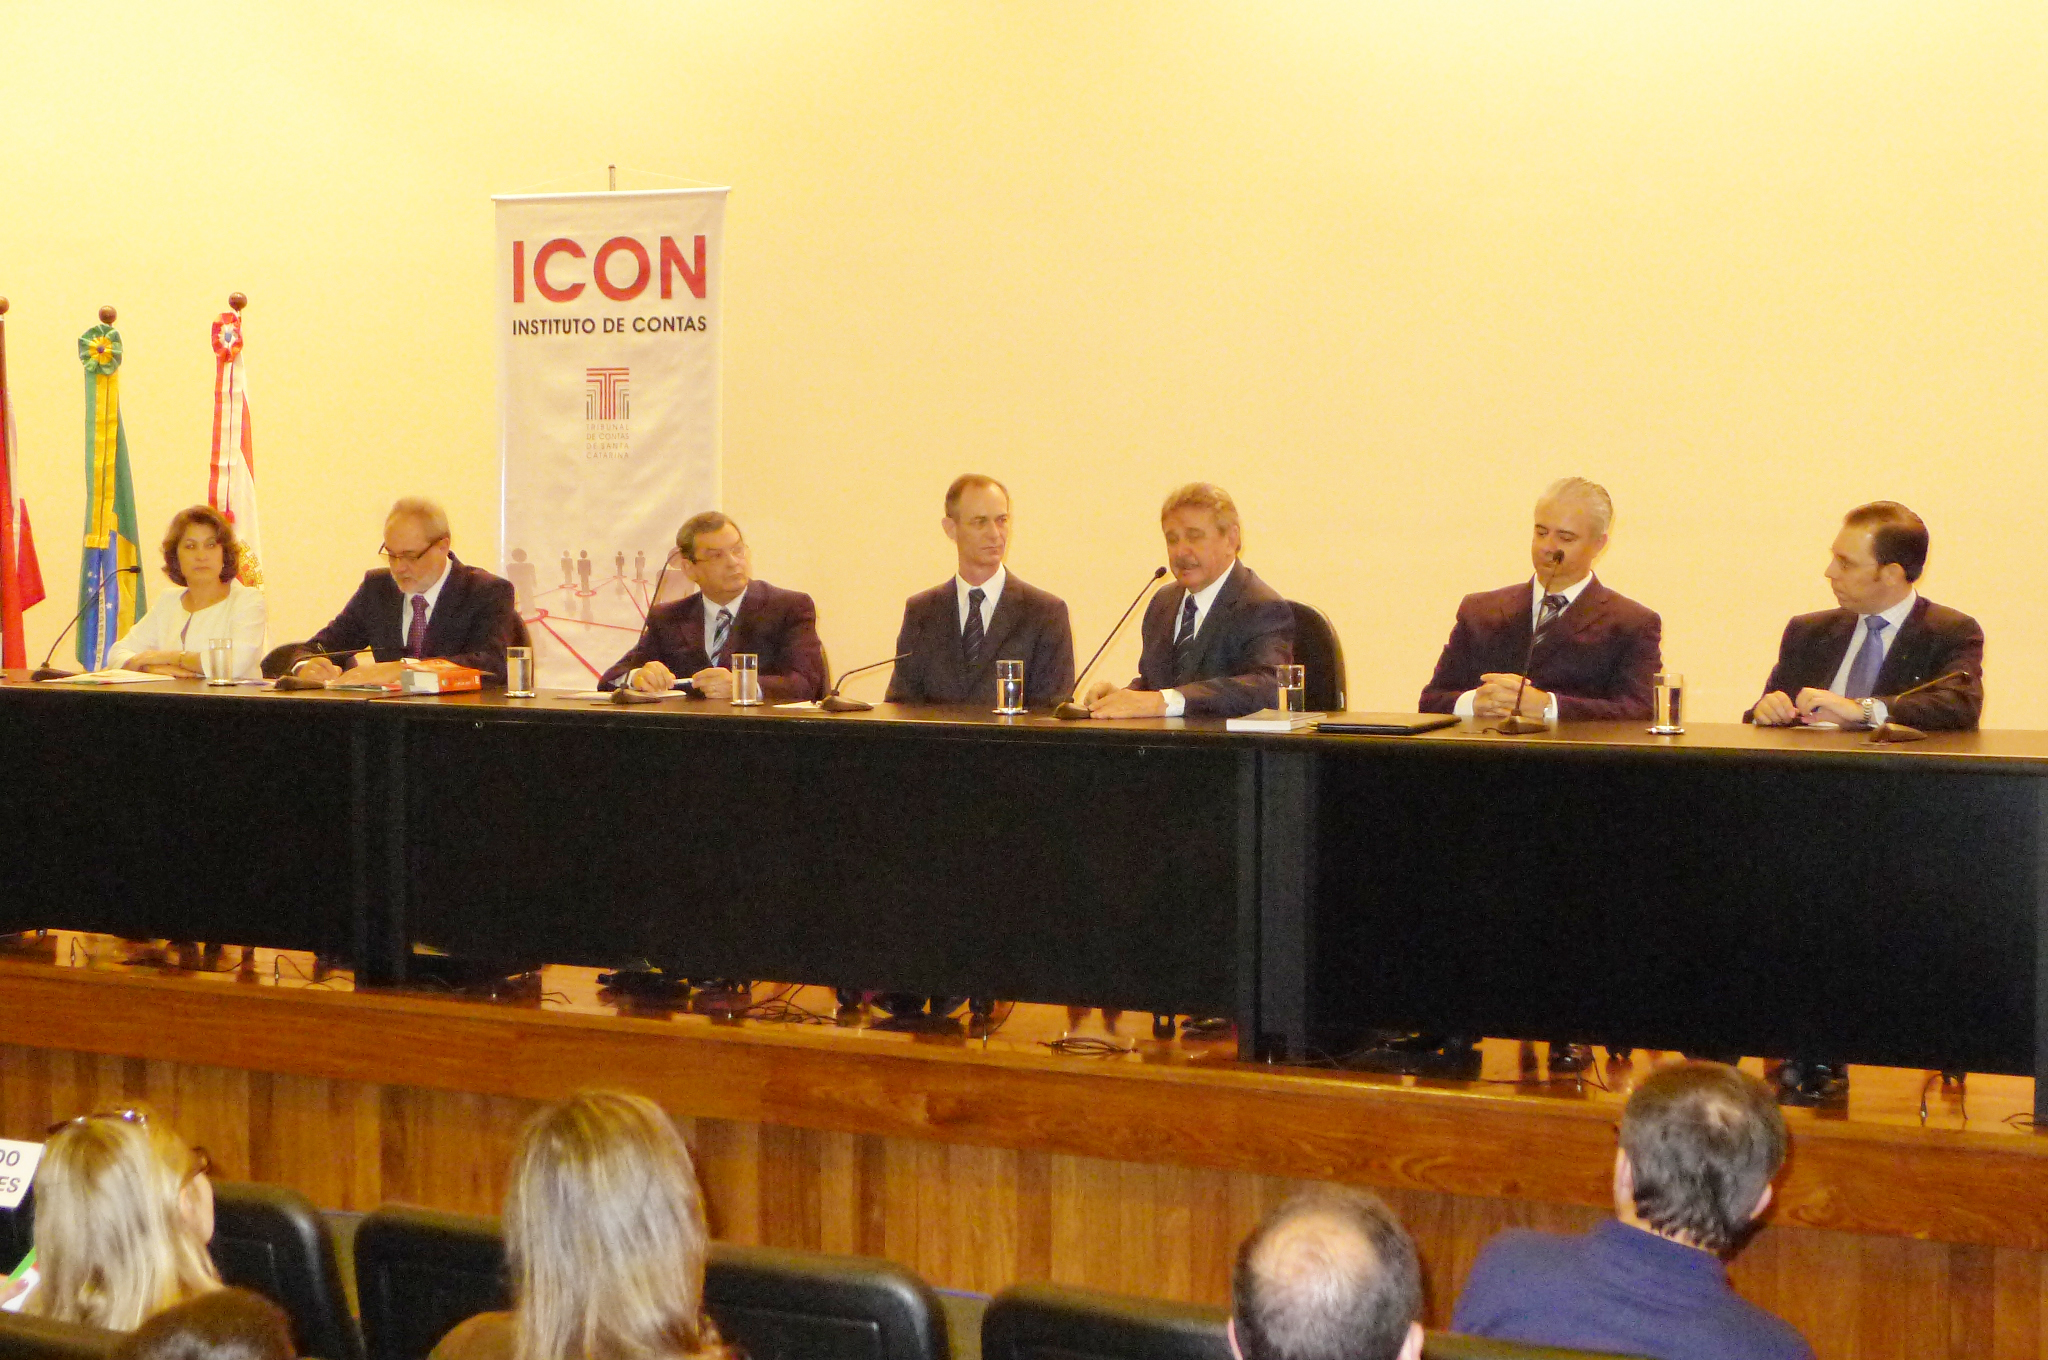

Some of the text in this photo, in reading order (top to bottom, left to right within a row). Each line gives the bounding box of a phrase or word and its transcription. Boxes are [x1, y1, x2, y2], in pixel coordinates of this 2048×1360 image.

[513, 235, 706, 303] ICON
[513, 315, 707, 335] INSTITUTO DE CONTAS
[586, 432, 630, 440] DE CONTAS
[586, 442, 630, 450] DE SANTA
[586, 451, 630, 459] CATARINA
